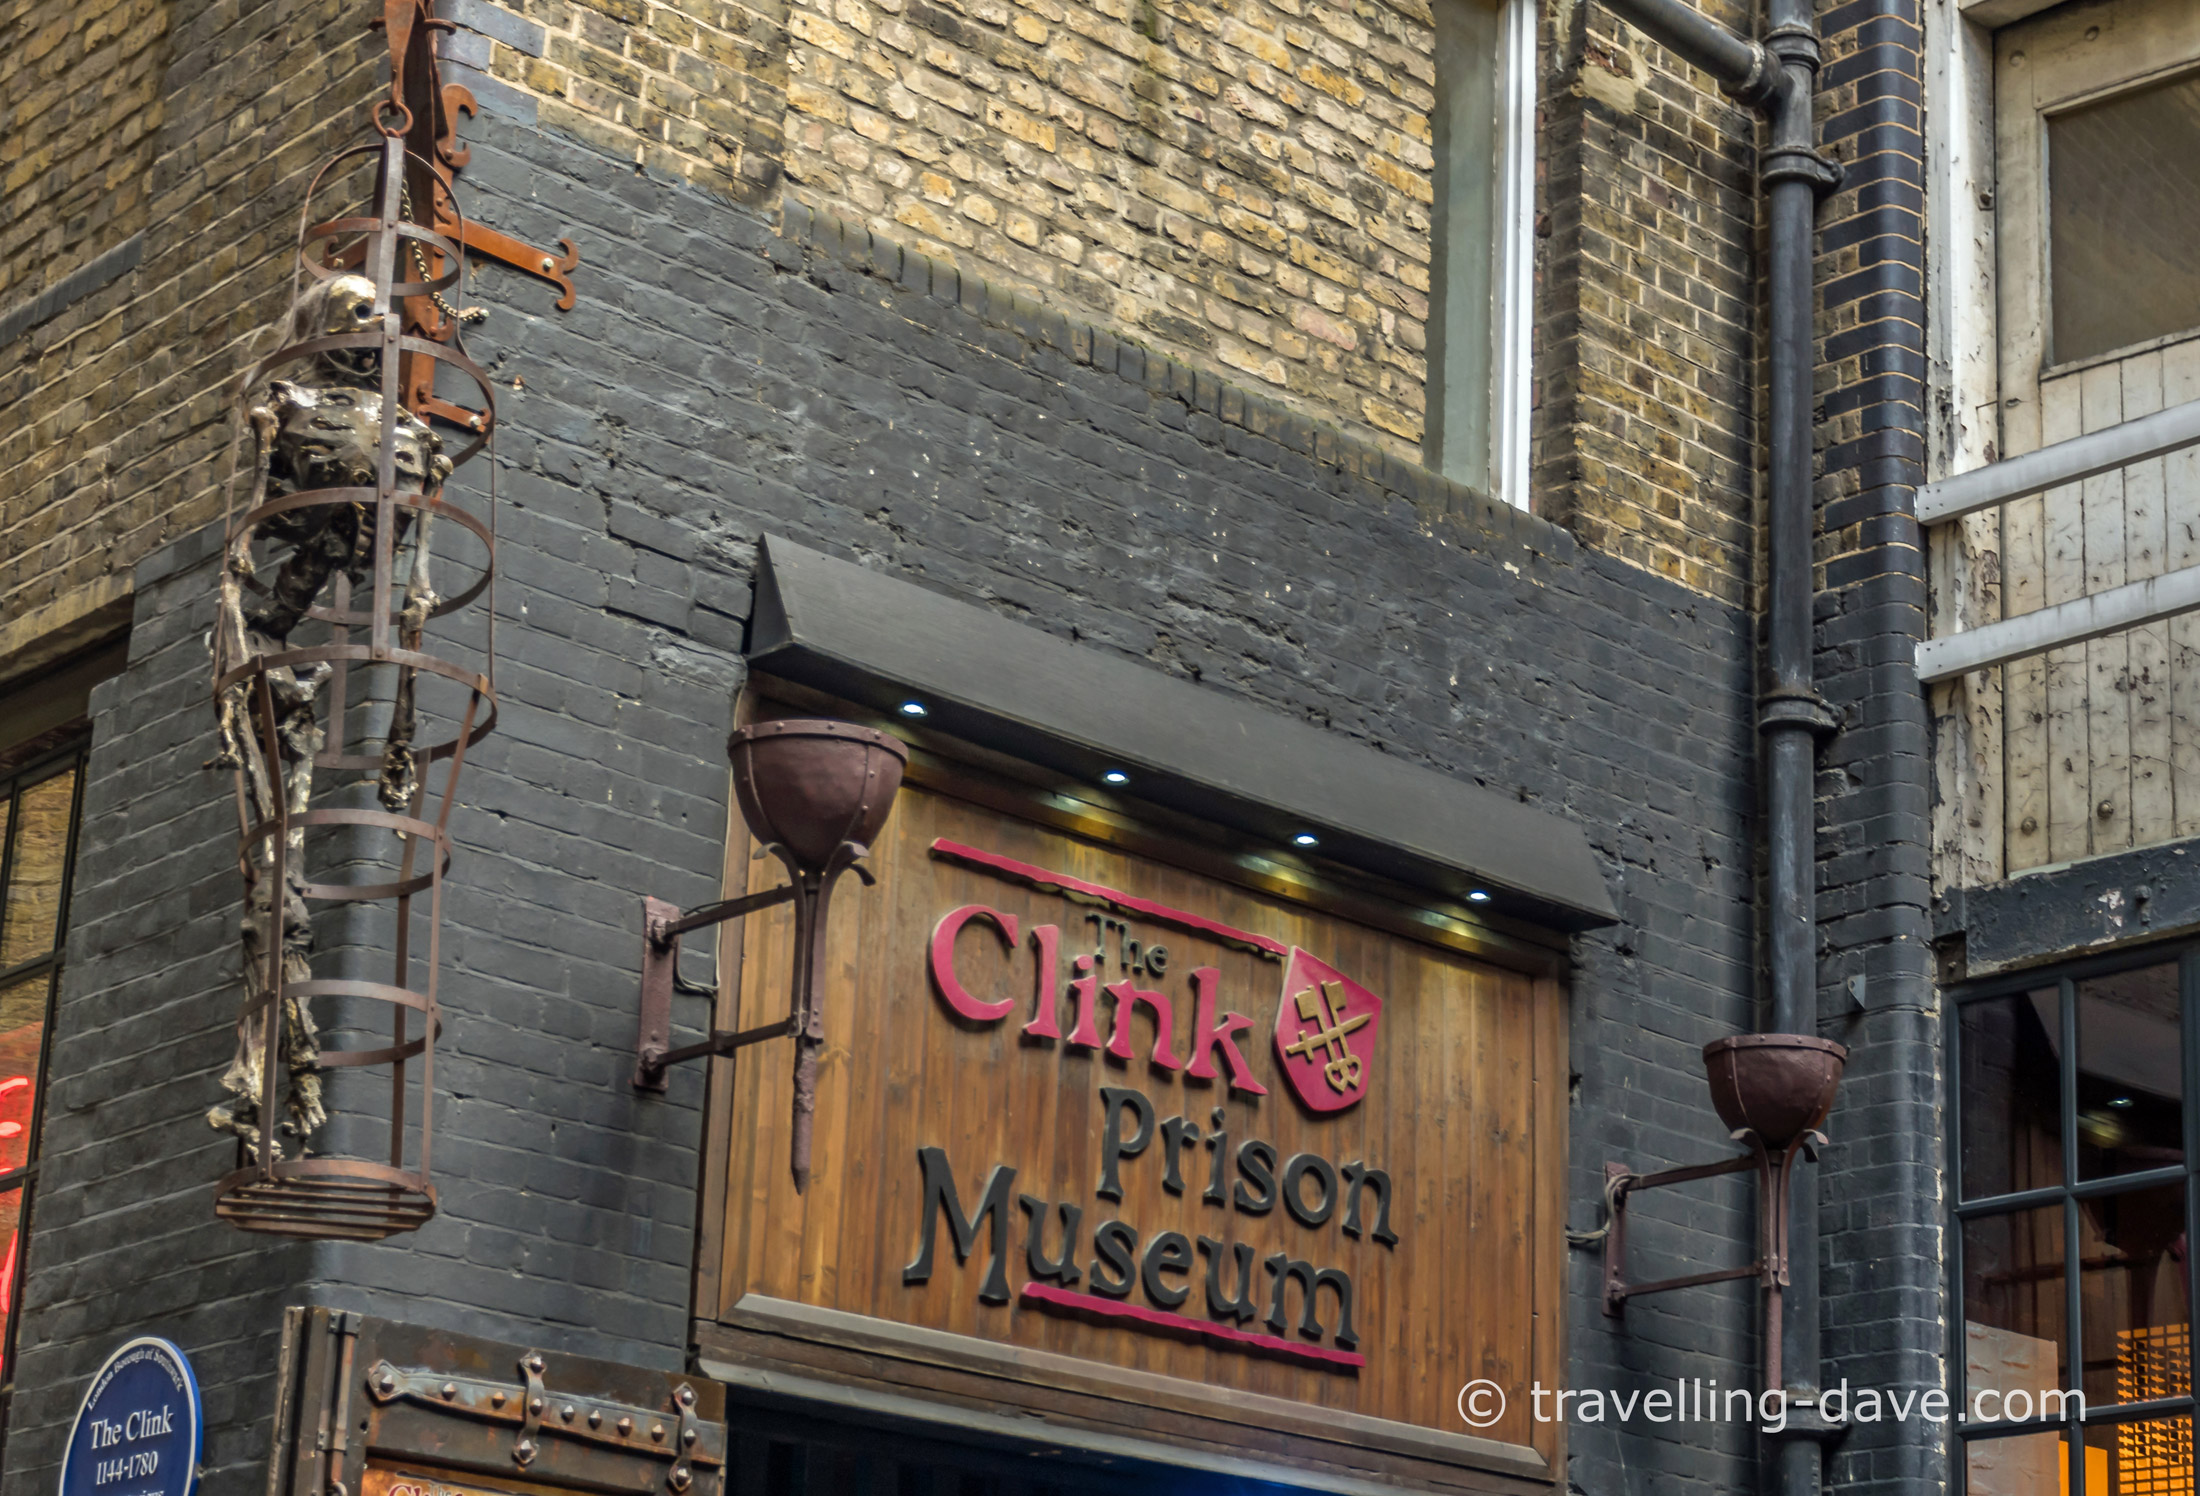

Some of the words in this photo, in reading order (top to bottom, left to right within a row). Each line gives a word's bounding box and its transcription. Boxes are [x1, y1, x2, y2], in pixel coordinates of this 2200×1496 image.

[1087, 912, 1168, 975] The
[929, 904, 1268, 1097] Clink
[1096, 1087, 1399, 1248] Prison
[903, 1146, 1361, 1347] Museum
[91, 1418, 122, 1450] The
[126, 1404, 174, 1441] Clink
[96, 1450, 159, 1486] 1144-1780
